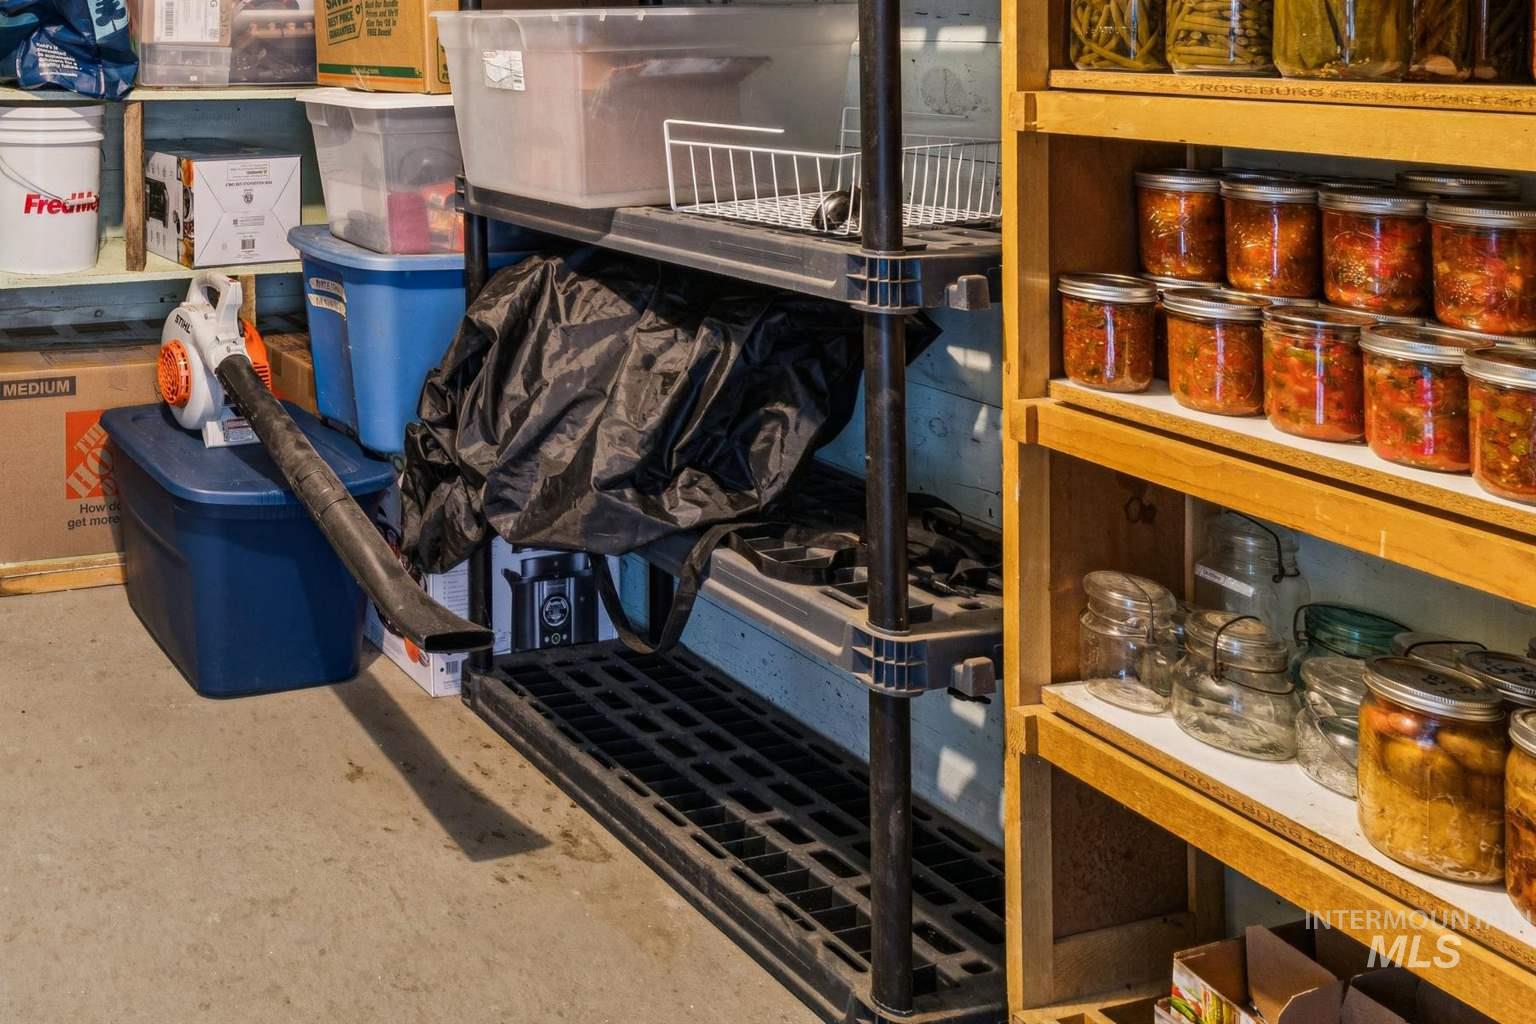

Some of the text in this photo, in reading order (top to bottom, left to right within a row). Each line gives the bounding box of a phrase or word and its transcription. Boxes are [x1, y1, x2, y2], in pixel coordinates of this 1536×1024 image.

[1198, 83, 1323, 97] ROSEBURG
[174, 314, 191, 334] STIHL
[2, 379, 71, 397] MEDIUM
[80, 503, 105, 514] How
[68, 514, 120, 530] get more
[1183, 770, 1303, 838] ROSEBURG
